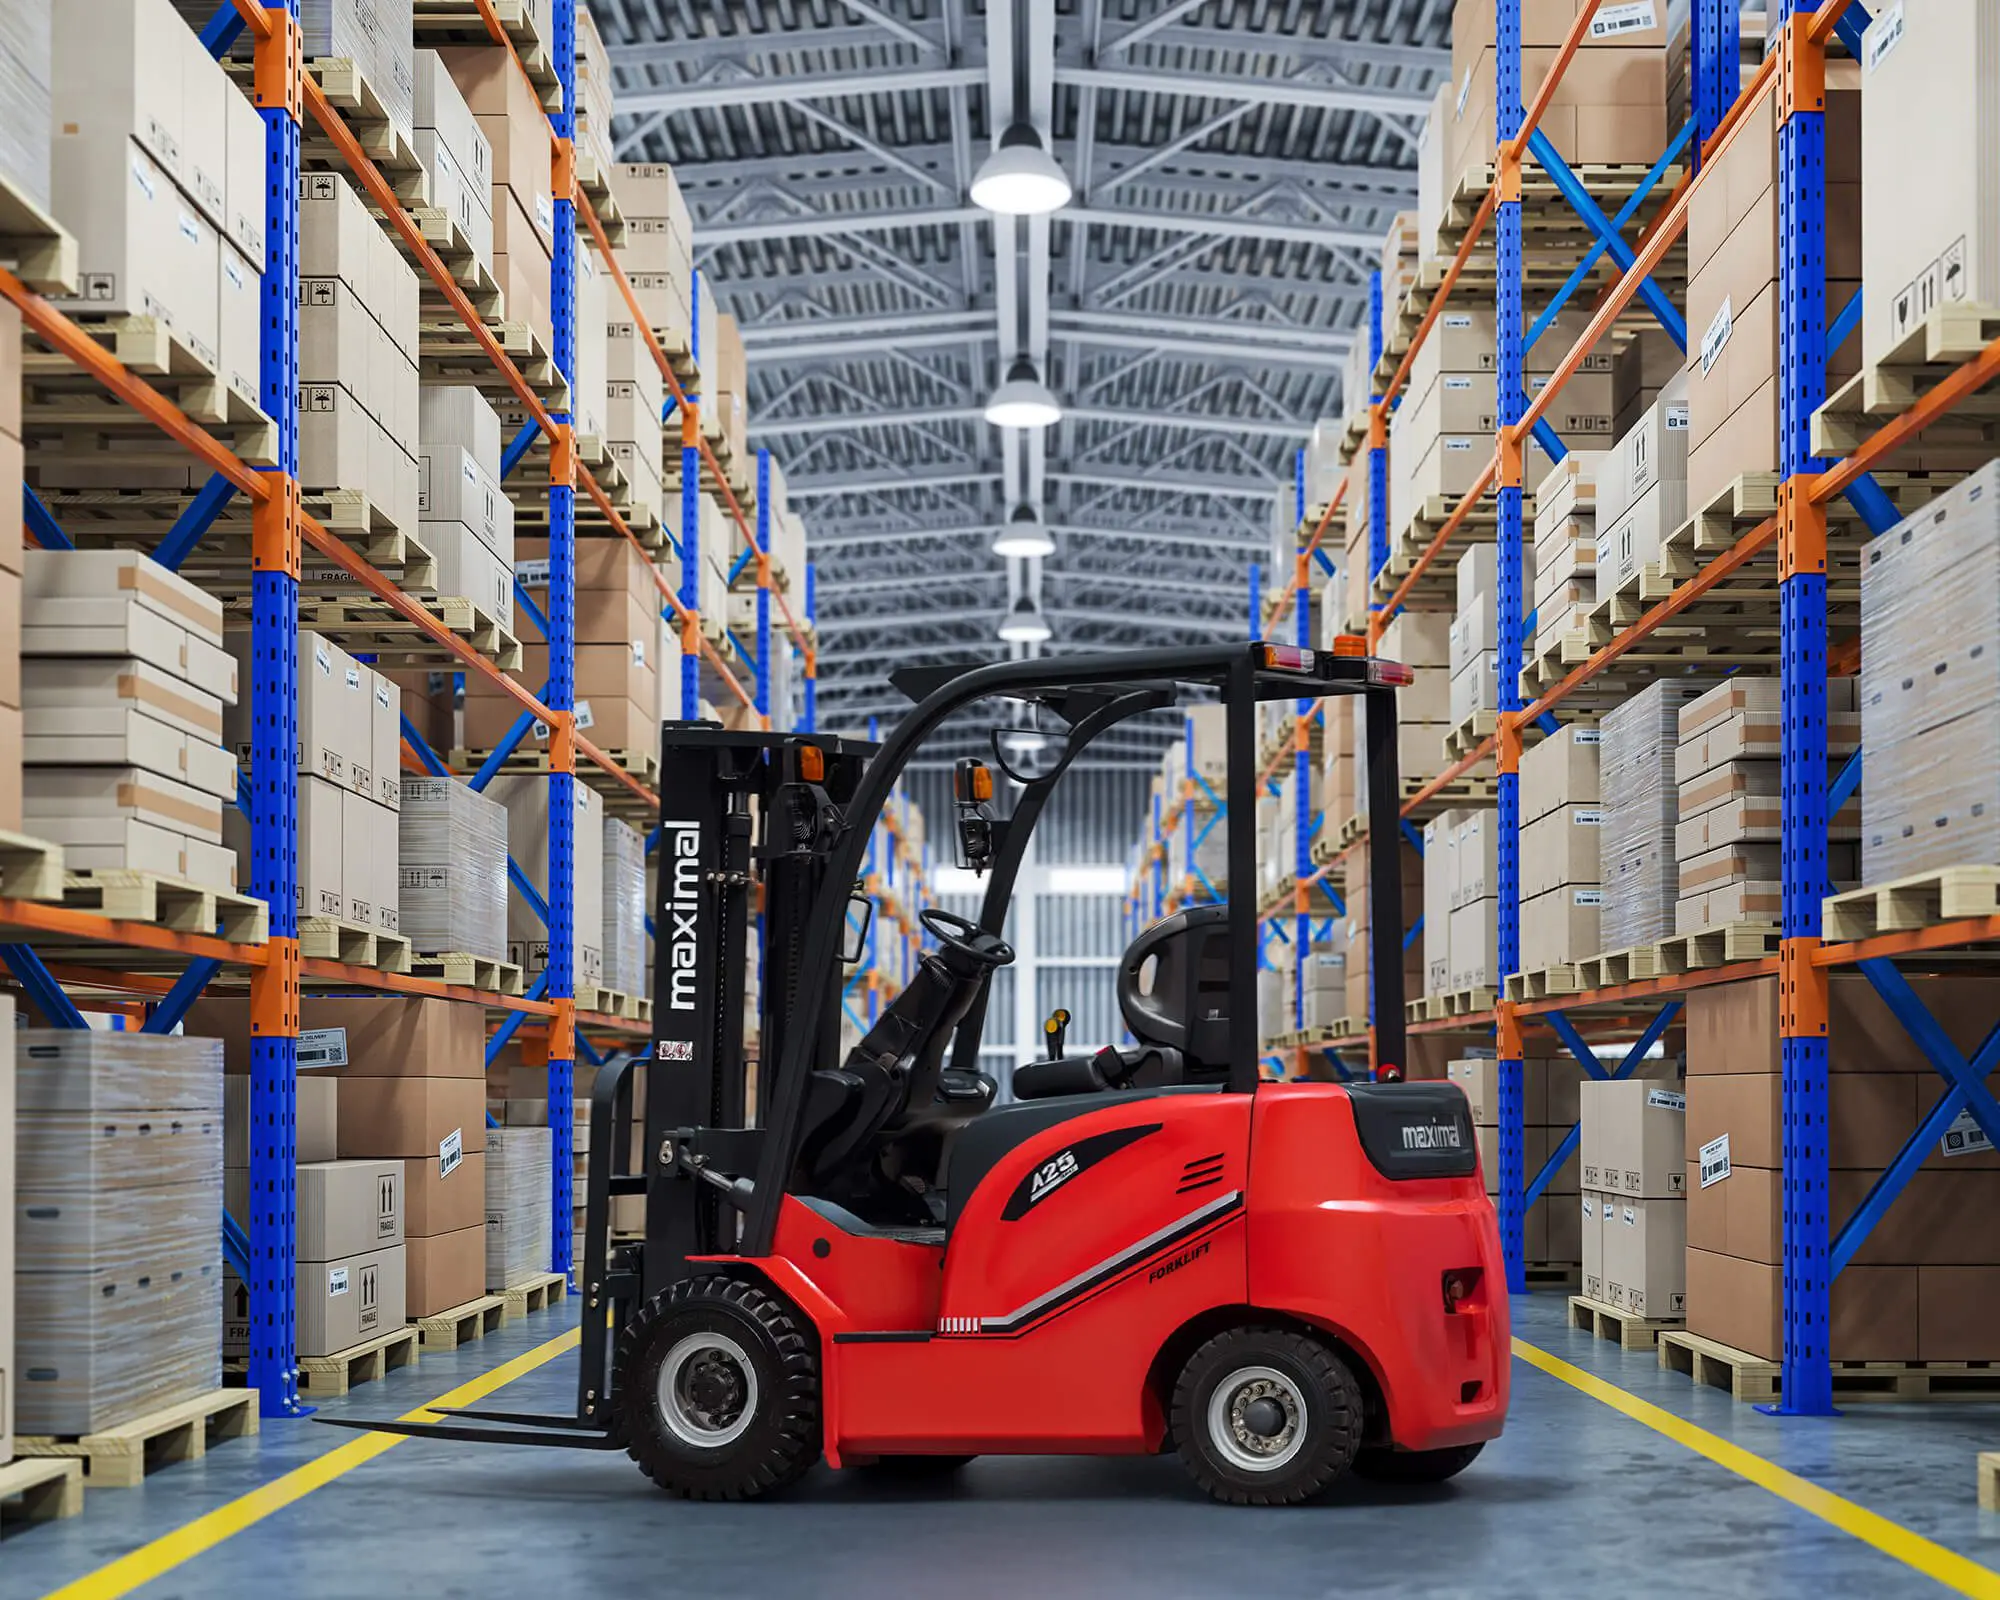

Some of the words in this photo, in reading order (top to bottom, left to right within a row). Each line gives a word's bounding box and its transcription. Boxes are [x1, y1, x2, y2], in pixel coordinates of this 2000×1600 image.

[664, 820, 700, 1010] maximal
[1402, 1115, 1461, 1149] maximal
[1031, 1150, 1075, 1193] A25
[1149, 1240, 1212, 1284] FORKLIFT
